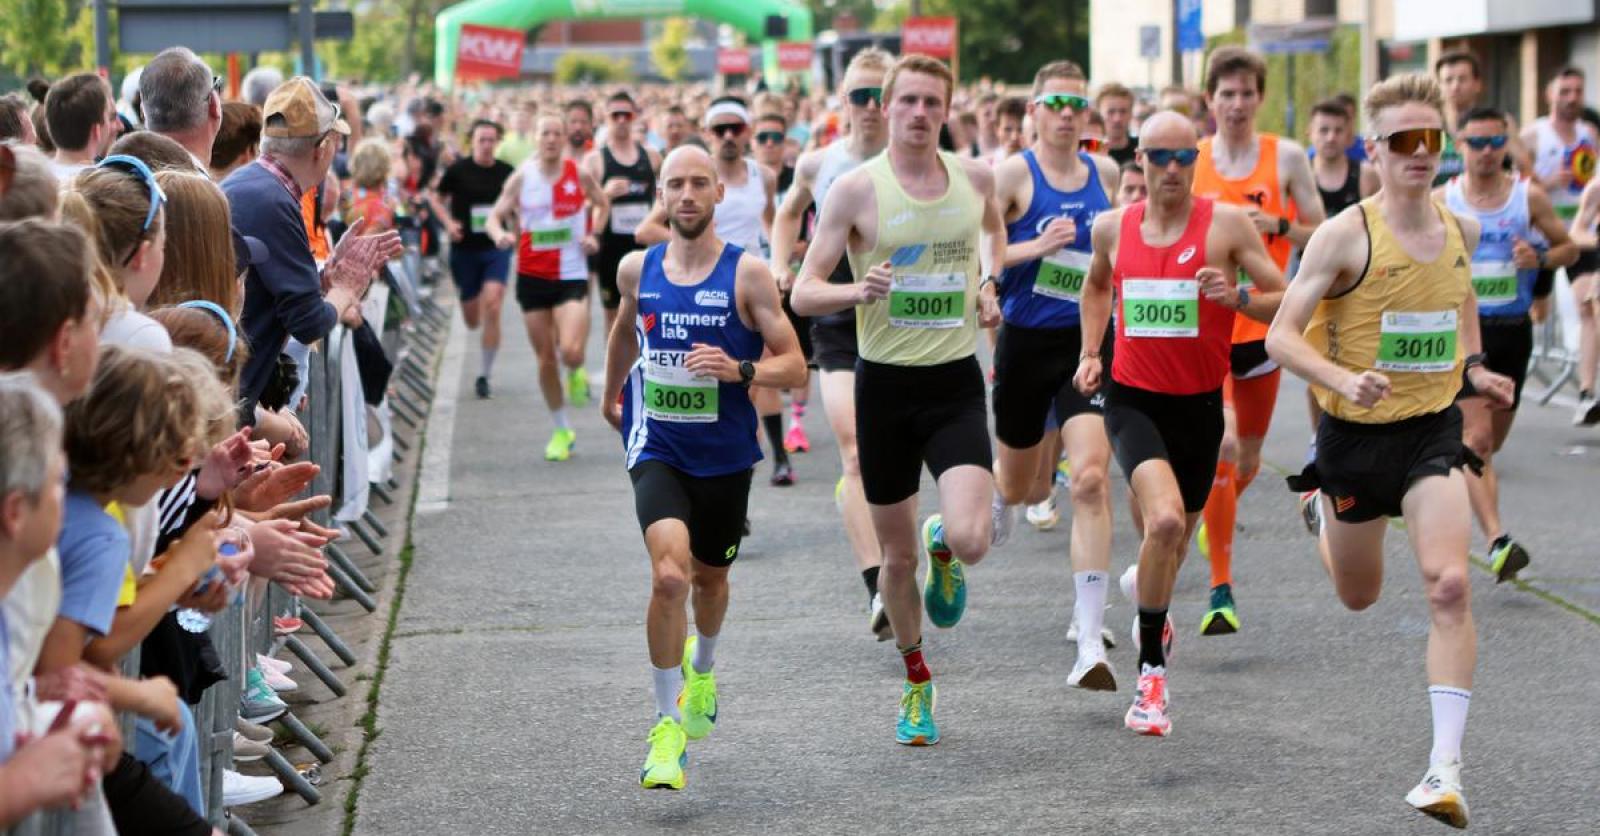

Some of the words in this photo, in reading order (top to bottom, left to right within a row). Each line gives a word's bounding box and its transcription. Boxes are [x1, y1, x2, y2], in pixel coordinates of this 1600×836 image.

[461, 33, 516, 65] KW
[1049, 269, 1083, 291] 300
[1474, 279, 1509, 297] 020
[903, 296, 953, 316] 3001
[1133, 303, 1187, 324] 3005
[660, 311, 732, 328] runners'
[661, 325, 688, 340] lab
[1393, 335, 1447, 359] 3010
[653, 388, 706, 410] 3003
